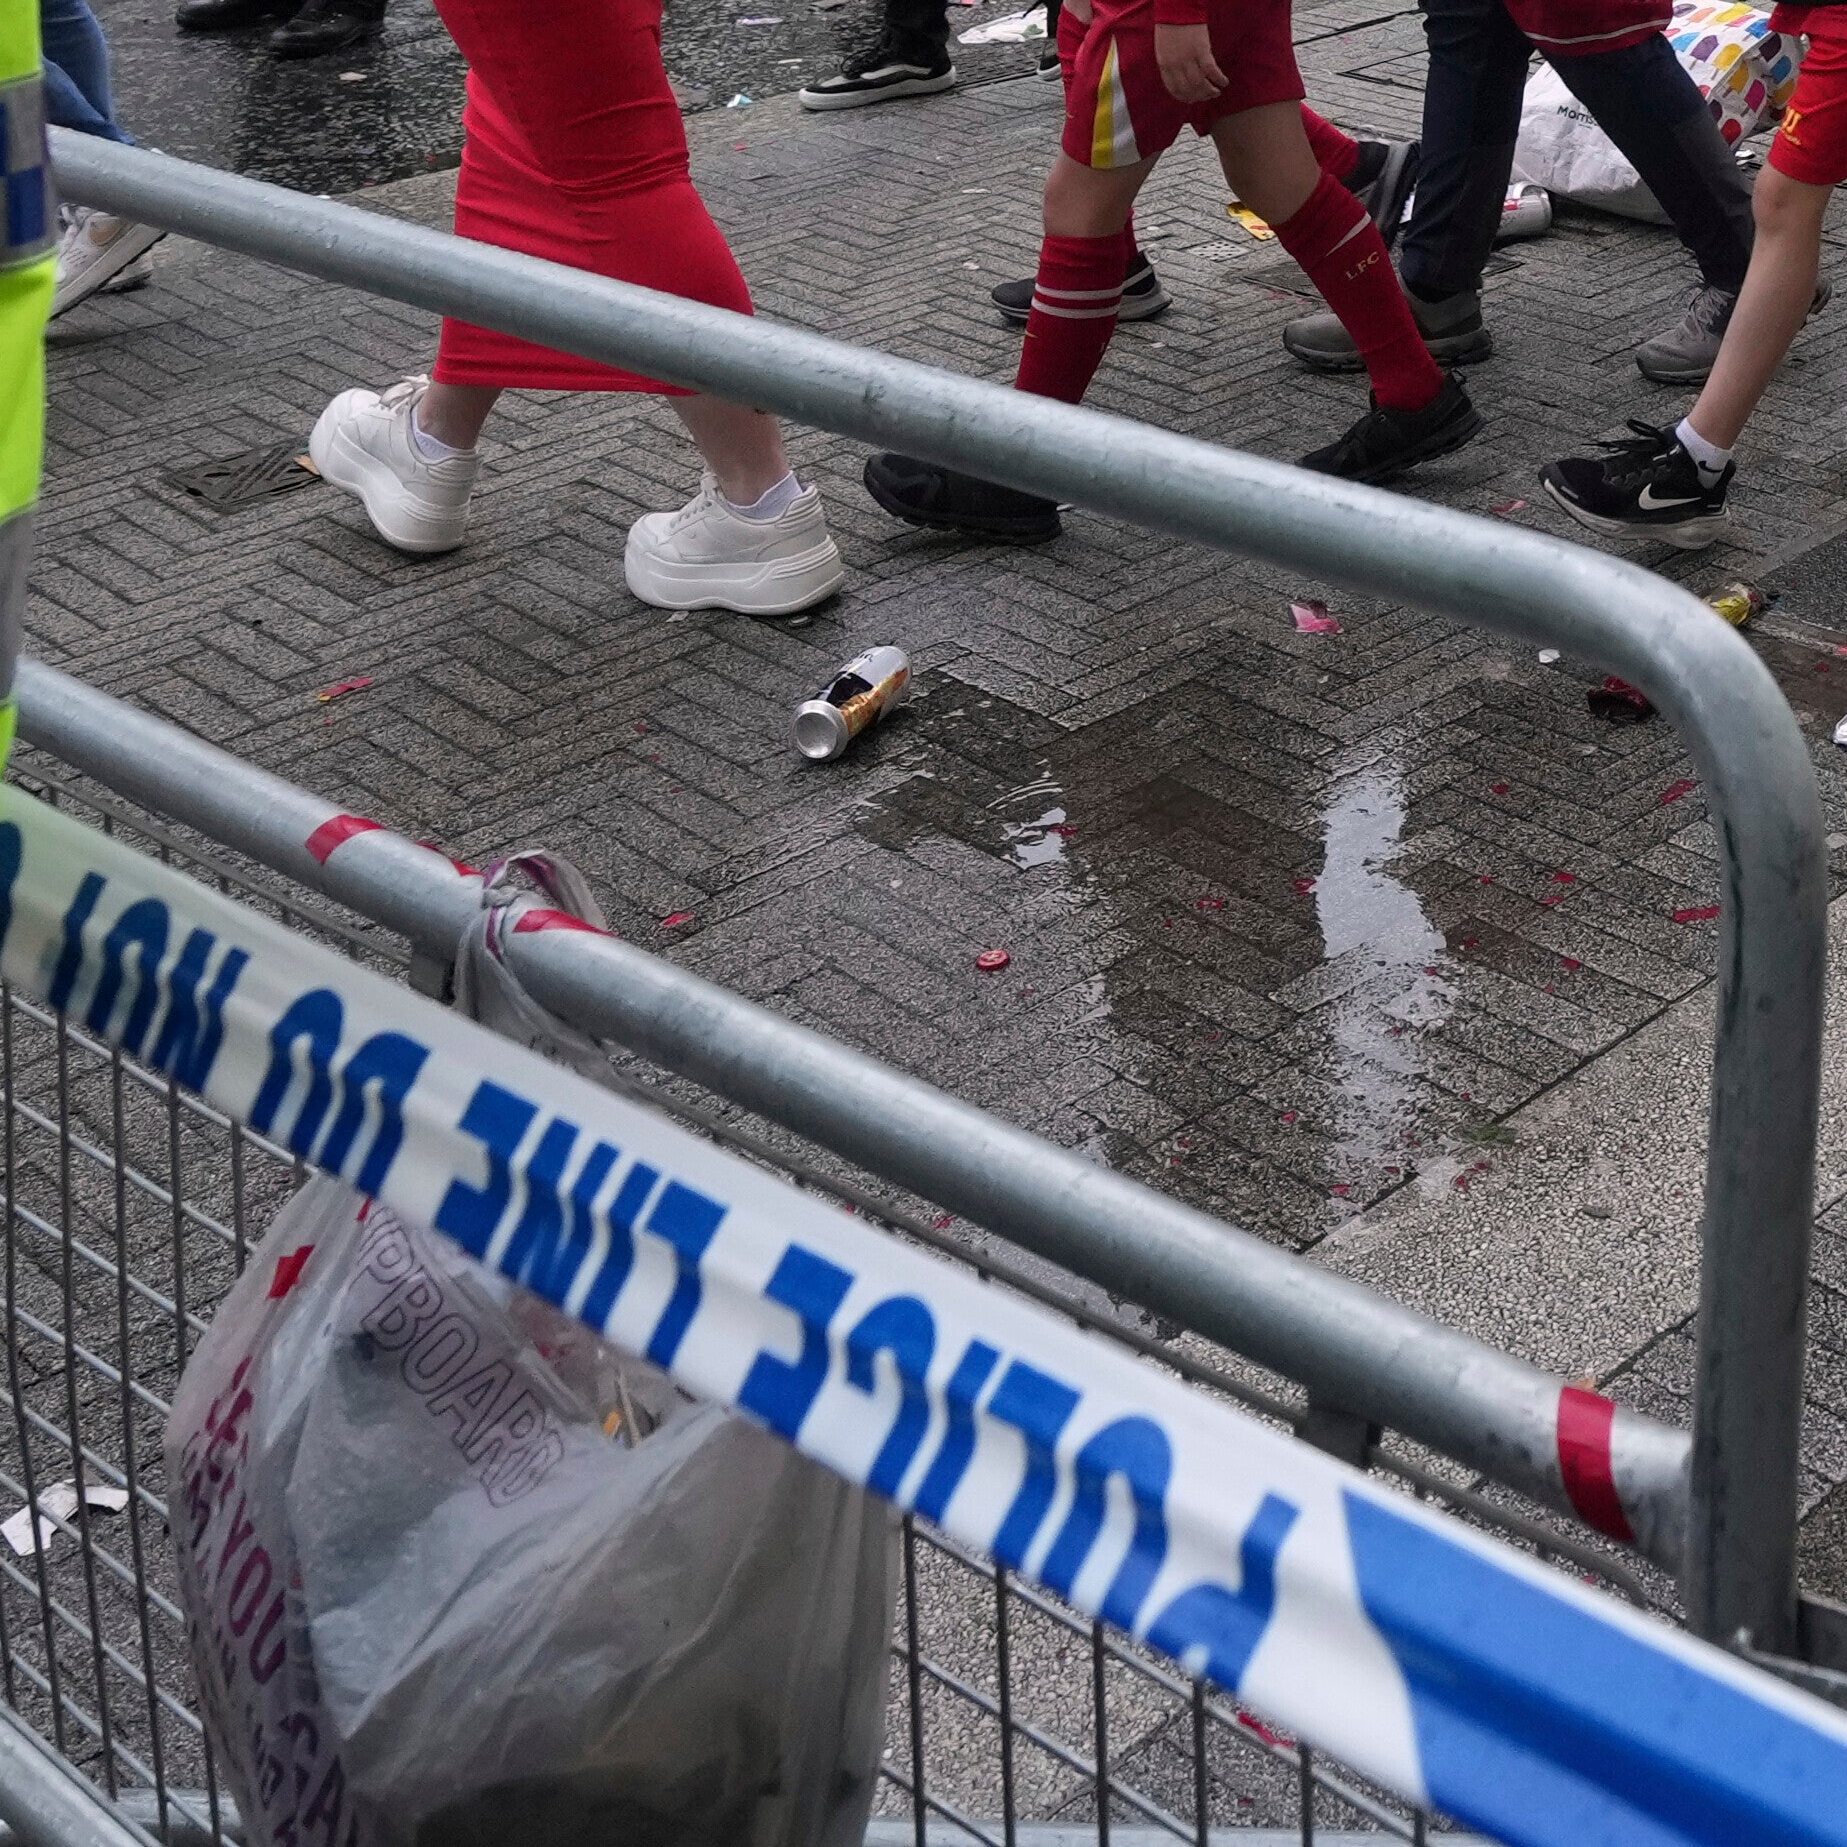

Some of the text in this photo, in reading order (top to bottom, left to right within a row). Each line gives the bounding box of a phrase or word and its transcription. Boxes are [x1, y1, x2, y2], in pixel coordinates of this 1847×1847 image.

[1556, 105, 1599, 127] Morris
[1346, 250, 1380, 281] LFC
[48, 870, 251, 1093] NOT
[249, 988, 431, 1200] DO
[432, 1079, 729, 1371] LINE
[737, 1243, 1300, 1698] POLICE
